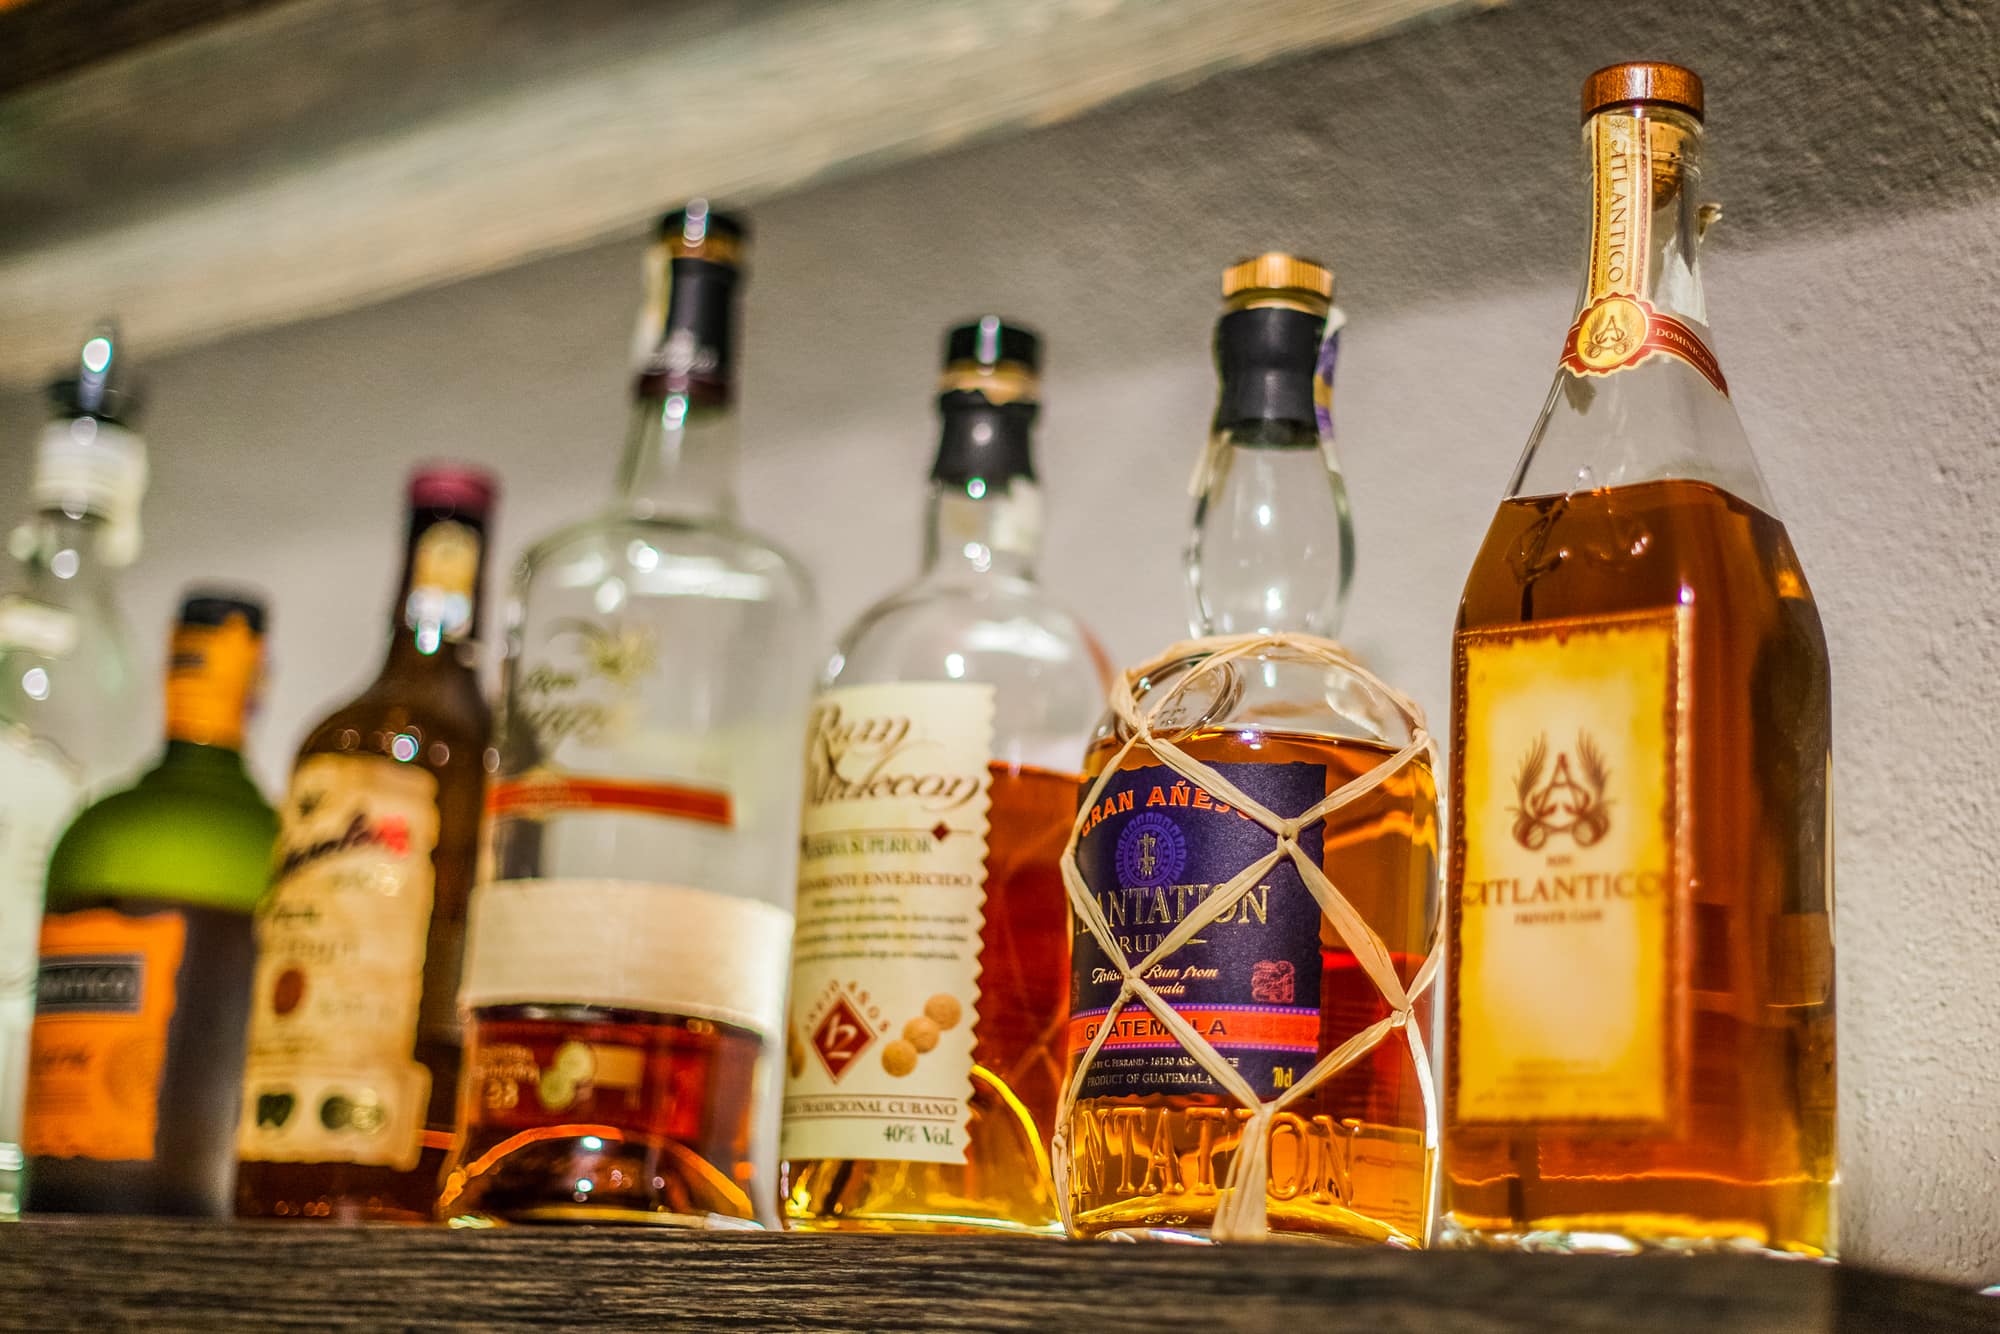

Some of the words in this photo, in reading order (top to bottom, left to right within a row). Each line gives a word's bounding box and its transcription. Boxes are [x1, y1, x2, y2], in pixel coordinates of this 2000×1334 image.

[1607, 138, 1627, 283] ATLANTICO
[1146, 780, 1251, 821] AÑE
[1076, 883, 1272, 936] ANTATON
[1143, 963, 1180, 980] Rum
[1180, 964, 1219, 981] from
[1085, 1017, 1228, 1042] GATEMLA
[1087, 1075, 1124, 1088] PRODUCT
[1126, 1073, 1140, 1084] OF
[1142, 1072, 1213, 1085] GUATEMALA
[887, 1102, 958, 1116] CUBANO
[883, 1123, 916, 1144] 40%
